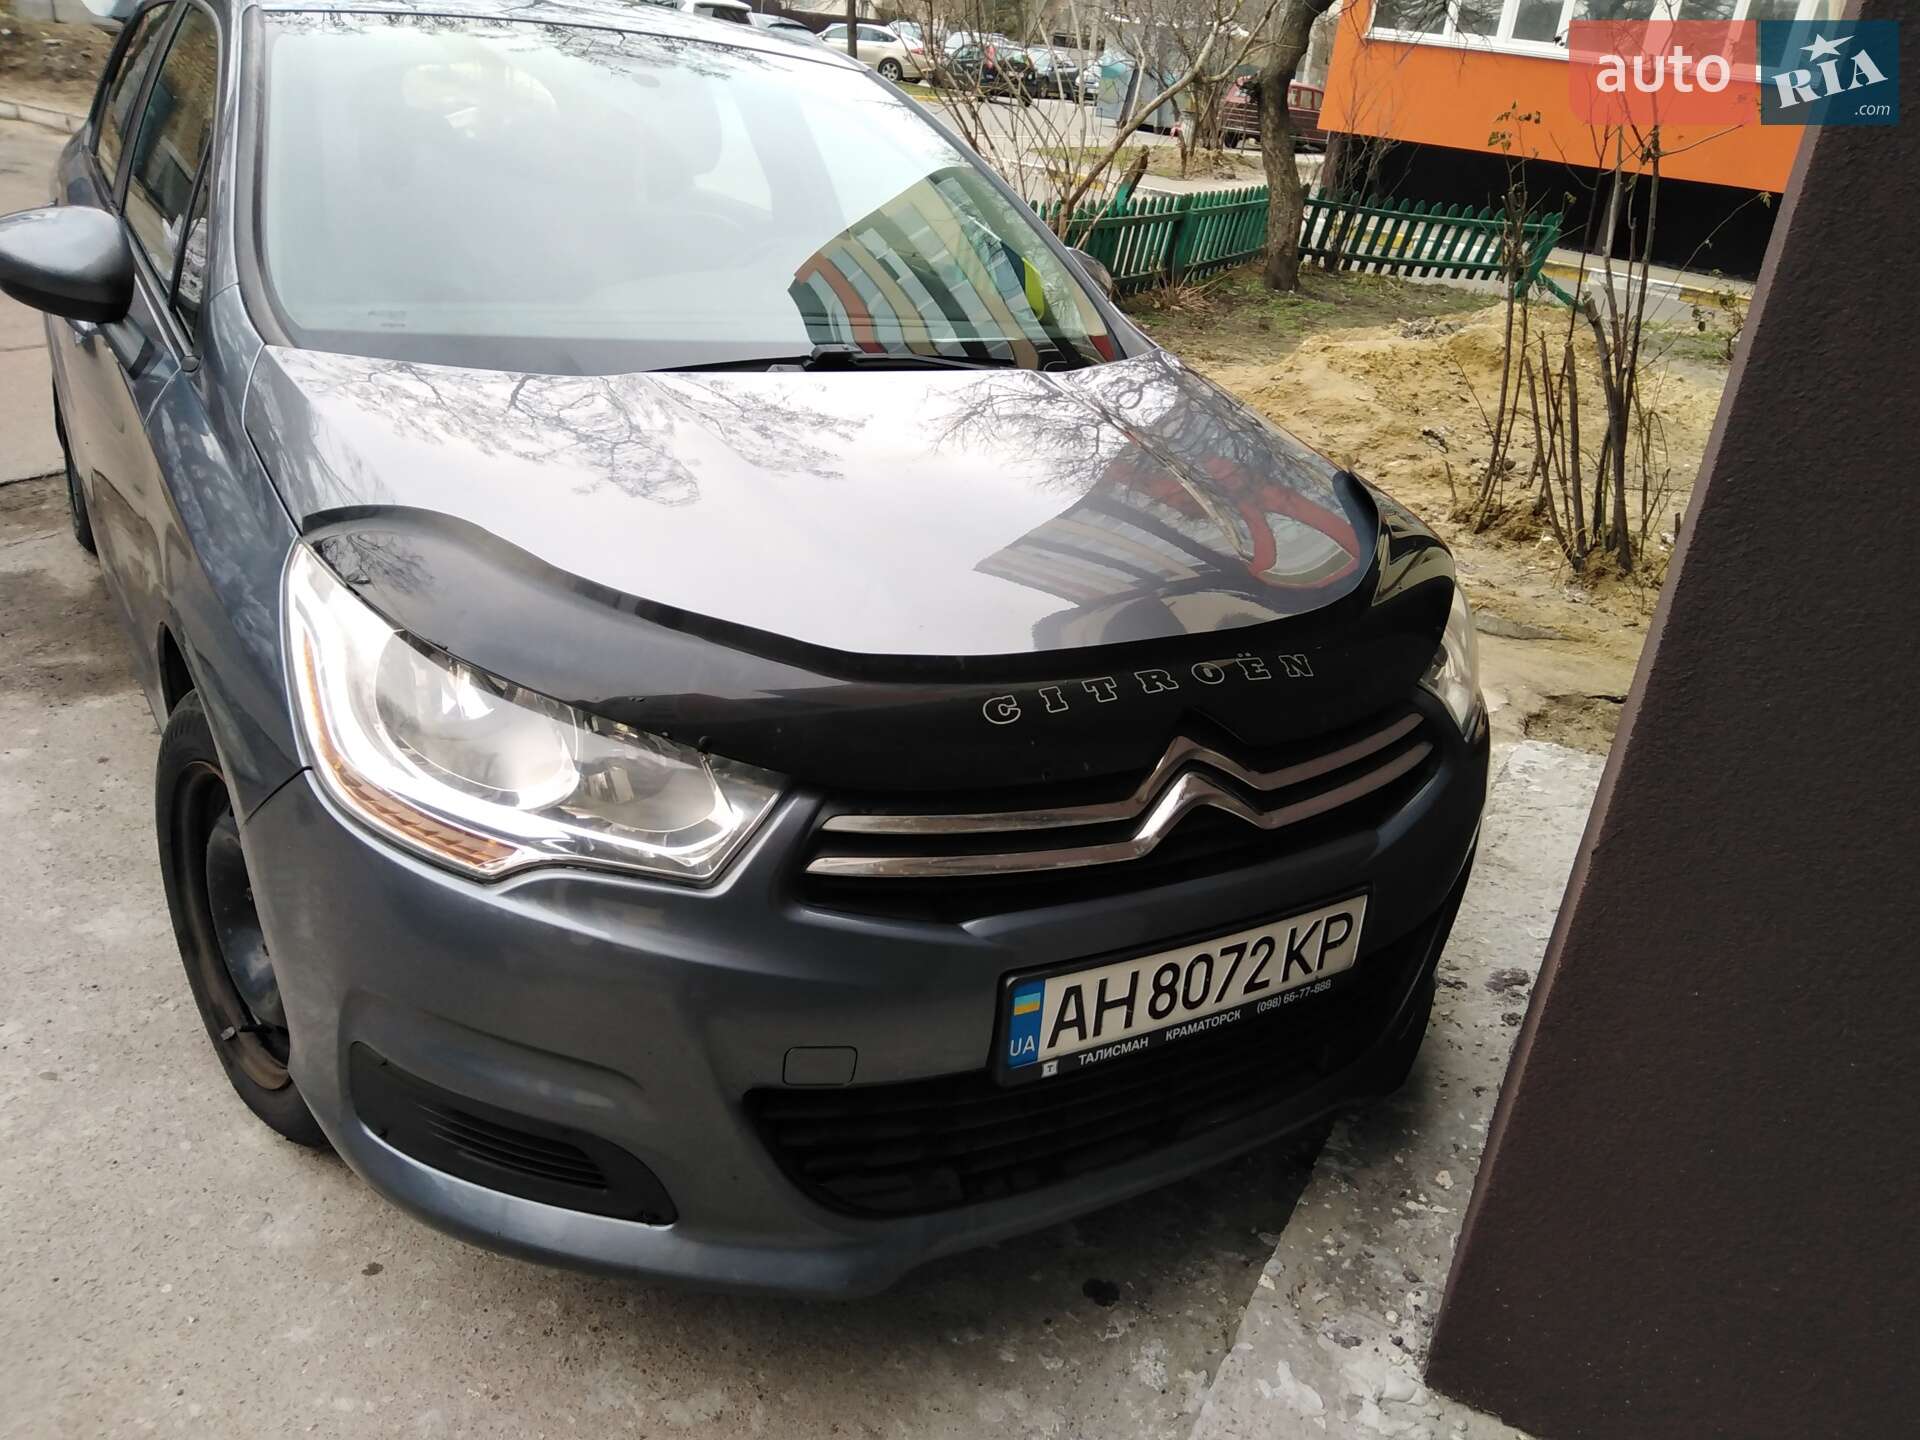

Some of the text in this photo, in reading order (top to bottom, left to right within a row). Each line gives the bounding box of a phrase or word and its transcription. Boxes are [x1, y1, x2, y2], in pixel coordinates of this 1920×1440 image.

[983, 652, 1314, 725] CITROËN
[1009, 1034, 1035, 1057] UA
[1078, 1036, 1150, 1066] ТАЛИСМАН
[1165, 1009, 1241, 1042] КРАМАТОРСК
[1256, 996, 1282, 1014] (098)
